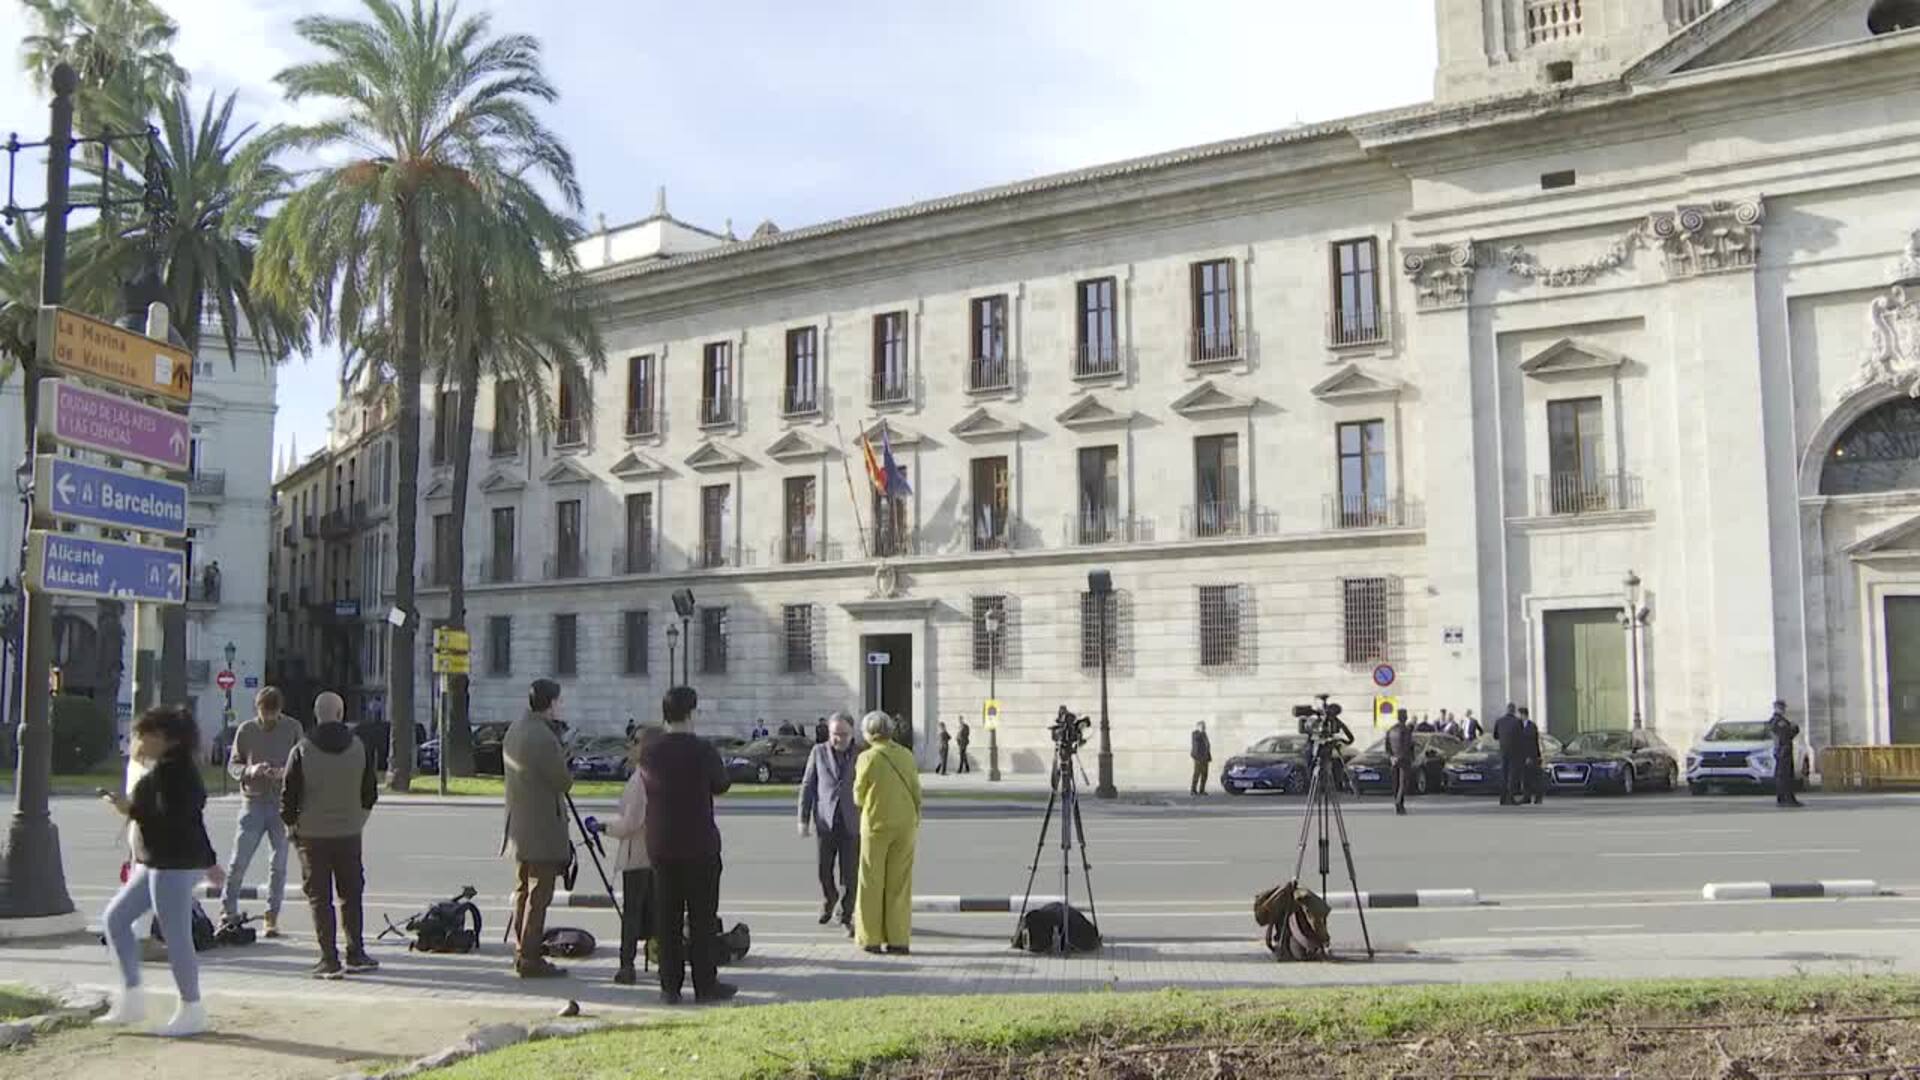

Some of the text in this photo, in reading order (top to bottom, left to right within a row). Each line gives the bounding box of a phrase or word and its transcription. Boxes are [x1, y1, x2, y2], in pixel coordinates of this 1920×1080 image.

[59, 312, 127, 353] La Marina
[57, 344, 73, 361] de
[60, 392, 157, 433] CIUDAD DE LAS ARTES
[101, 483, 183, 521] Barcelona
[48, 543, 105, 566] Alicante
[47, 565, 99, 587] Alacant
